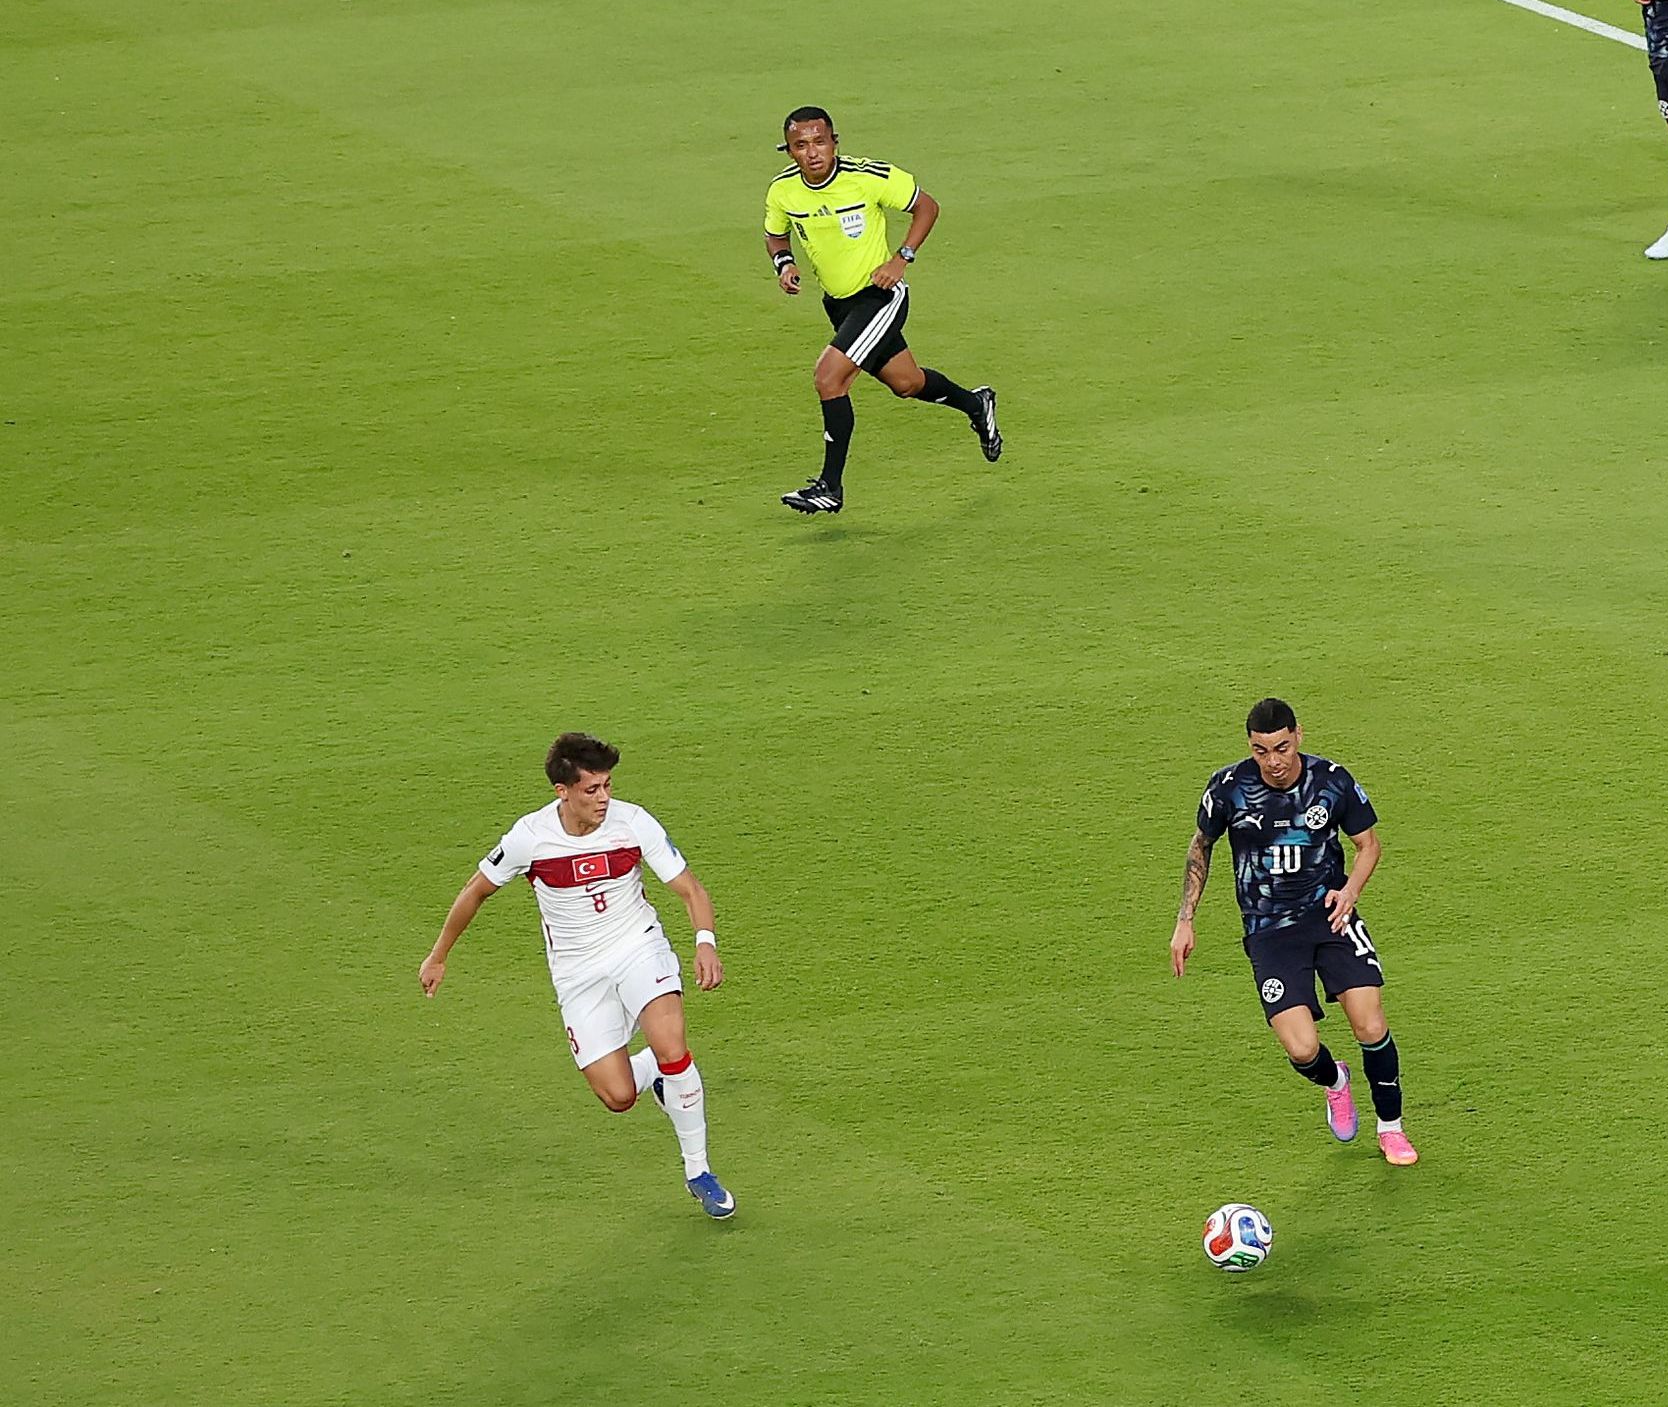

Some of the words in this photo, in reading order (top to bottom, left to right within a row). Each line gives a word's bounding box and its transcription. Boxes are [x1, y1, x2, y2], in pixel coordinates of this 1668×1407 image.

[842, 213, 862, 224] FIFA
[1268, 844, 1302, 875] 10
[592, 891, 609, 914] 8
